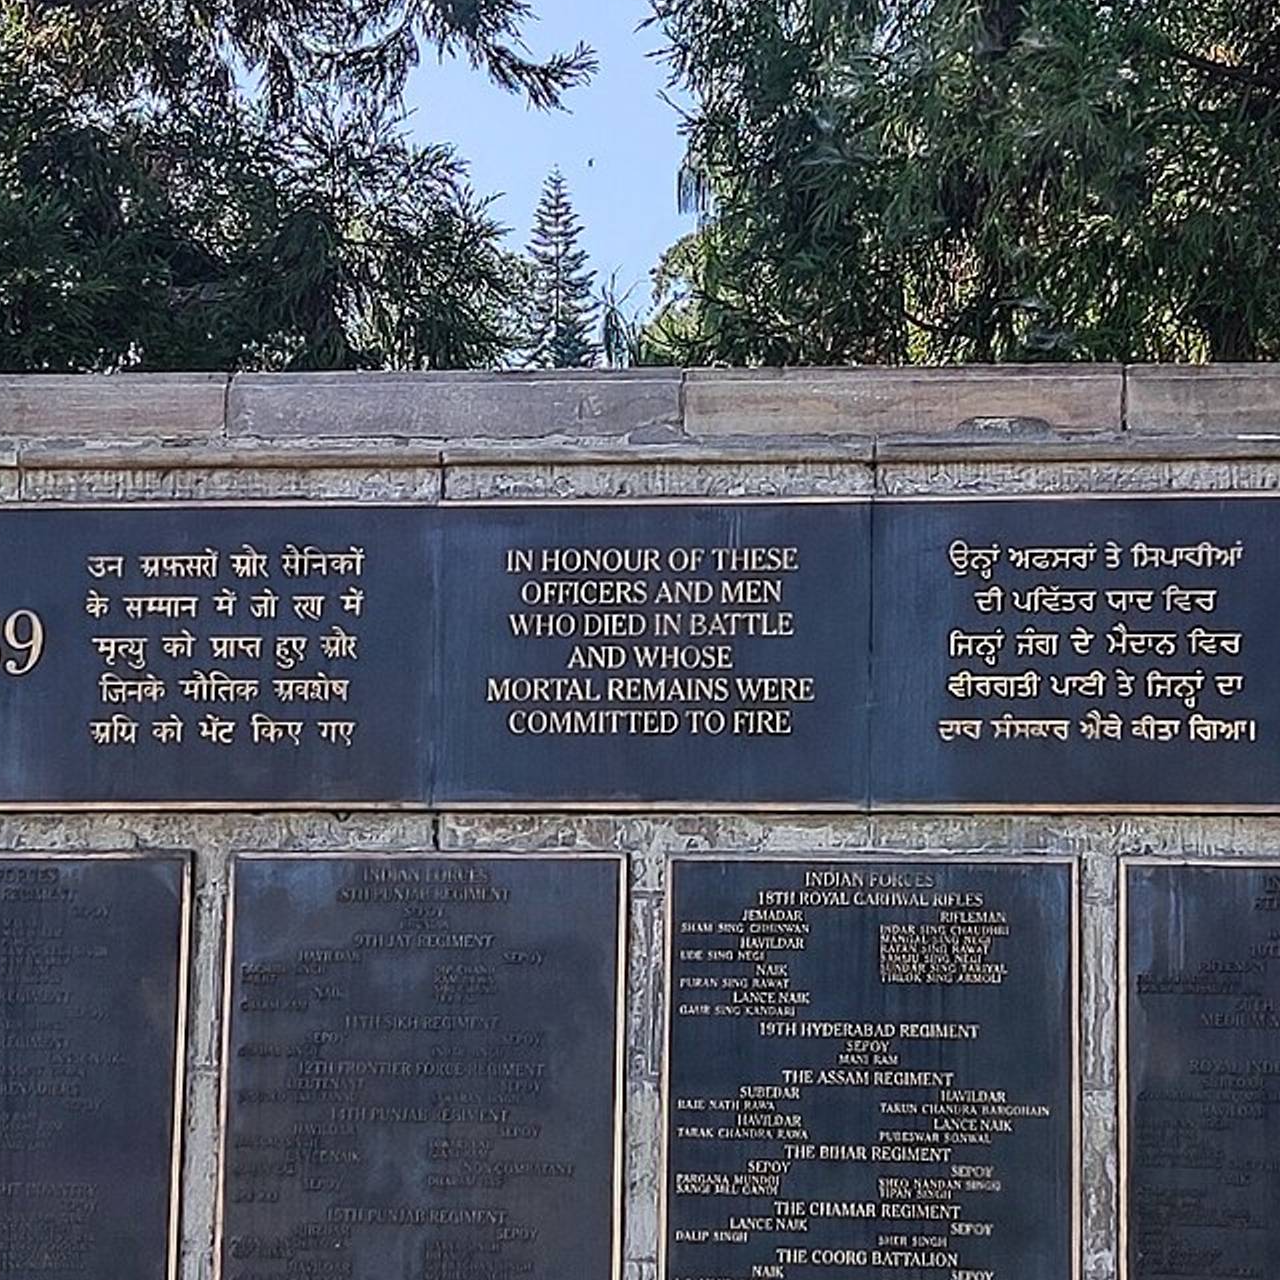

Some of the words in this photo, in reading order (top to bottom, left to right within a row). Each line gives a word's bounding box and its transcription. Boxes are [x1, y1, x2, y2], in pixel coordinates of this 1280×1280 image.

[88, 557, 123, 577] उन
[230, 544, 268, 577] और
[282, 544, 365, 576] सैनिकों
[507, 550, 532, 571] IN
[542, 549, 660, 571] HONOUR
[669, 548, 704, 571] OF
[712, 548, 798, 570] THESE
[1105, 542, 1122, 567] ਤੇ
[86, 590, 109, 617] के
[123, 597, 198, 617] सम्मान
[213, 588, 236, 616] में
[251, 589, 279, 617] जो
[340, 588, 364, 615] में
[522, 581, 647, 604] OFFICERS
[655, 581, 713, 603] AND
[721, 581, 781, 603] MEN
[975, 587, 1002, 611] ਦੀ
[1105, 591, 1153, 611] ਯਾਦ
[1162, 585, 1216, 611] ਵਿਚ
[510, 614, 575, 636] WHO
[584, 614, 646, 635] DIED
[655, 614, 681, 635] IN
[691, 613, 793, 635] BATTLE
[162, 630, 196, 657] को
[209, 638, 262, 658] प्राप्त
[320, 626, 357, 658] और
[1016, 628, 1058, 655] ਜੰਗ
[1071, 627, 1094, 653] ਦੇ
[1106, 623, 1176, 654] ਮੈਦਾਨ
[1187, 628, 1242, 653] ਵਿਚ
[568, 646, 625, 668] AND
[634, 646, 732, 668] WHOSE
[99, 673, 165, 702] जिनके
[272, 672, 349, 701] अवशेष
[488, 679, 600, 701] MORTAL
[608, 678, 728, 701] REMAINS
[736, 678, 814, 700] WERE
[1116, 669, 1135, 696] ਤੇ
[1215, 676, 1243, 695] ਦਾ
[152, 714, 183, 742] को
[251, 714, 303, 745] किए
[317, 722, 355, 745] गए
[510, 711, 678, 733] COMMITTED
[686, 711, 725, 733] TO
[734, 711, 791, 733] FIRE
[759, 892, 795, 904] 18TH
[800, 892, 849, 905] ROYAL
[854, 892, 929, 905] GARHWAL
[933, 893, 983, 906] RIFLES
[761, 1022, 796, 1036] 19TH
[802, 1023, 895, 1037] HYDERABAD
[900, 1024, 979, 1038] REGIMENT
[782, 1070, 813, 1083] THE
[817, 1071, 868, 1084] ASSAM
[874, 1072, 954, 1086] REGIMENT
[784, 1145, 815, 1158] THE
[820, 1146, 867, 1159] BIHAR
[872, 1146, 951, 1161] REGIMENT
[776, 1249, 807, 1263] THE
[812, 1250, 867, 1265] COORG
[872, 1251, 957, 1267] BATTALION
